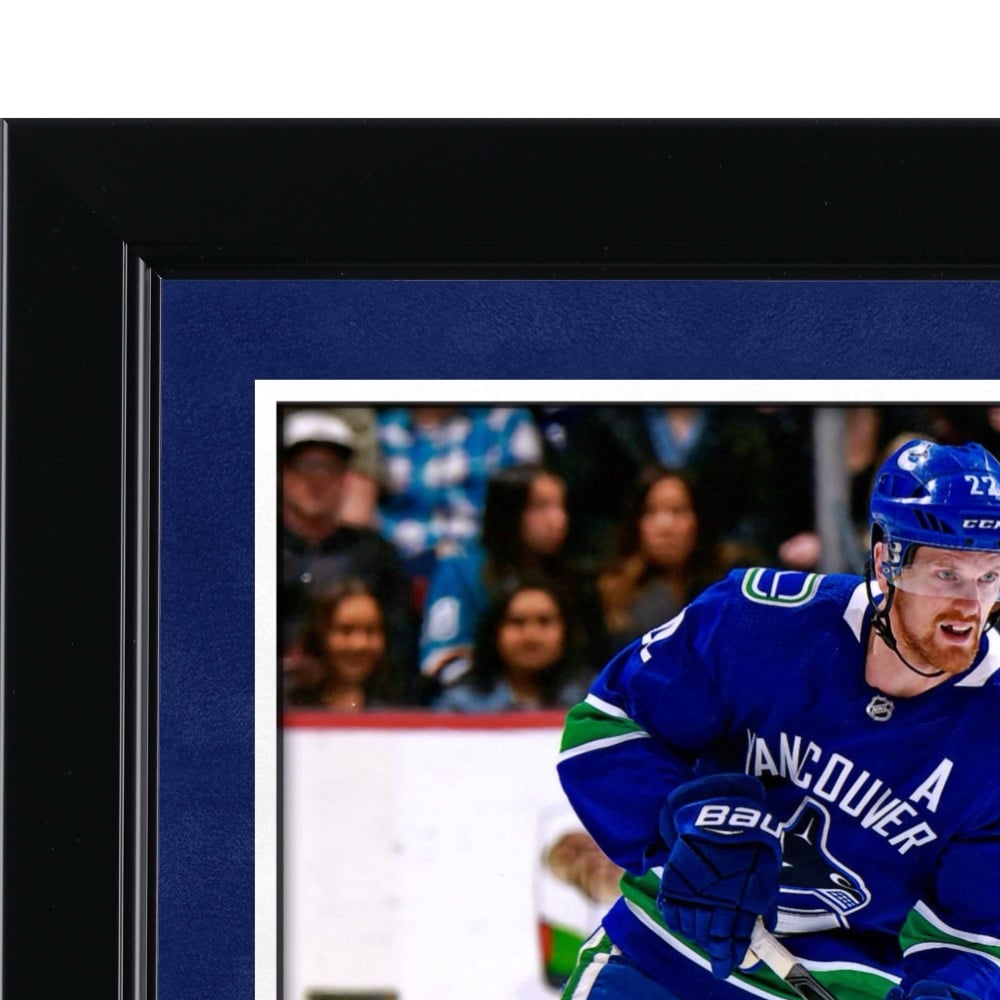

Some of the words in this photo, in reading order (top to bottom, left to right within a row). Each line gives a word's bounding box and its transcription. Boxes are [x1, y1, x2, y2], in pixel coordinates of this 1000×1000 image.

[963, 474, 1000, 496] 22
[745, 728, 938, 855] VANCOUVER
[909, 757, 954, 813] A
